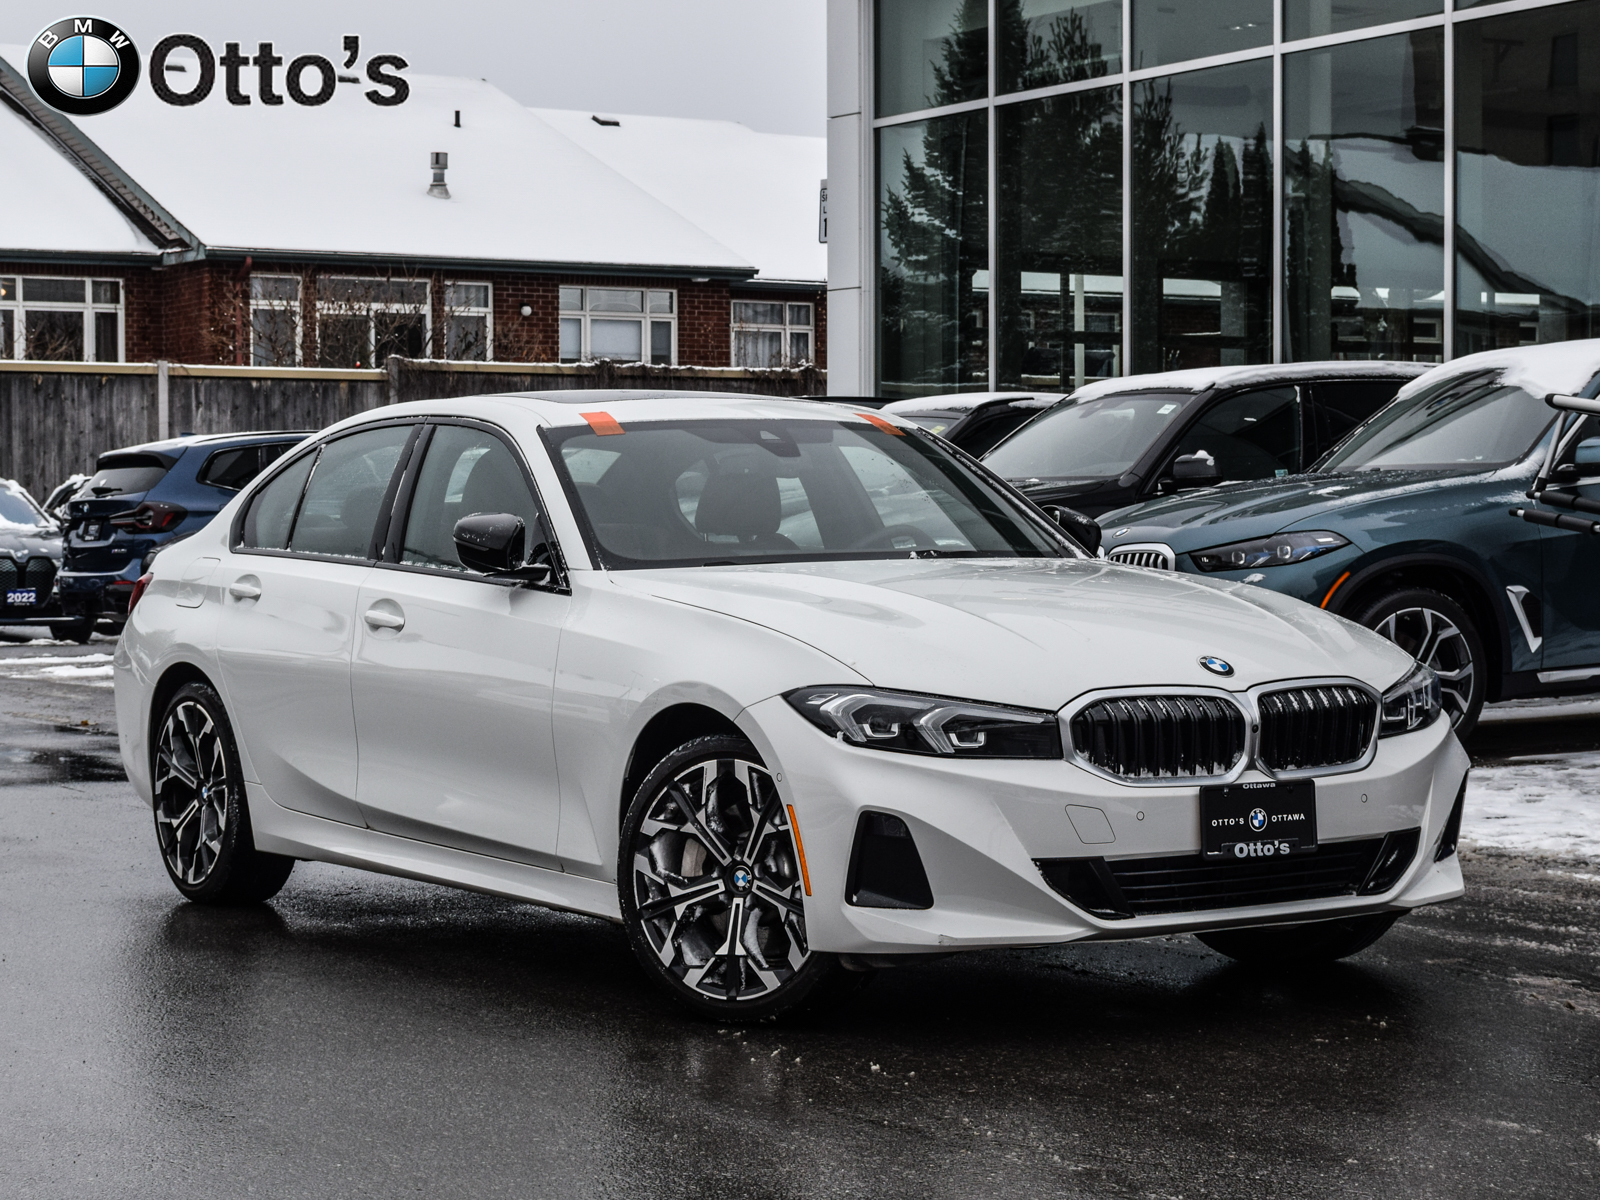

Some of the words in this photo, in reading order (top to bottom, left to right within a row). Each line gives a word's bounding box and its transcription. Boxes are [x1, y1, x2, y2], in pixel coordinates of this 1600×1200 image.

[7, 592, 36, 603] 2022
[1242, 782, 1276, 790] Ottawa
[1211, 817, 1245, 827] OTTO'S
[1271, 813, 1306, 823] OTTAWA
[1234, 840, 1290, 858] Otto's
